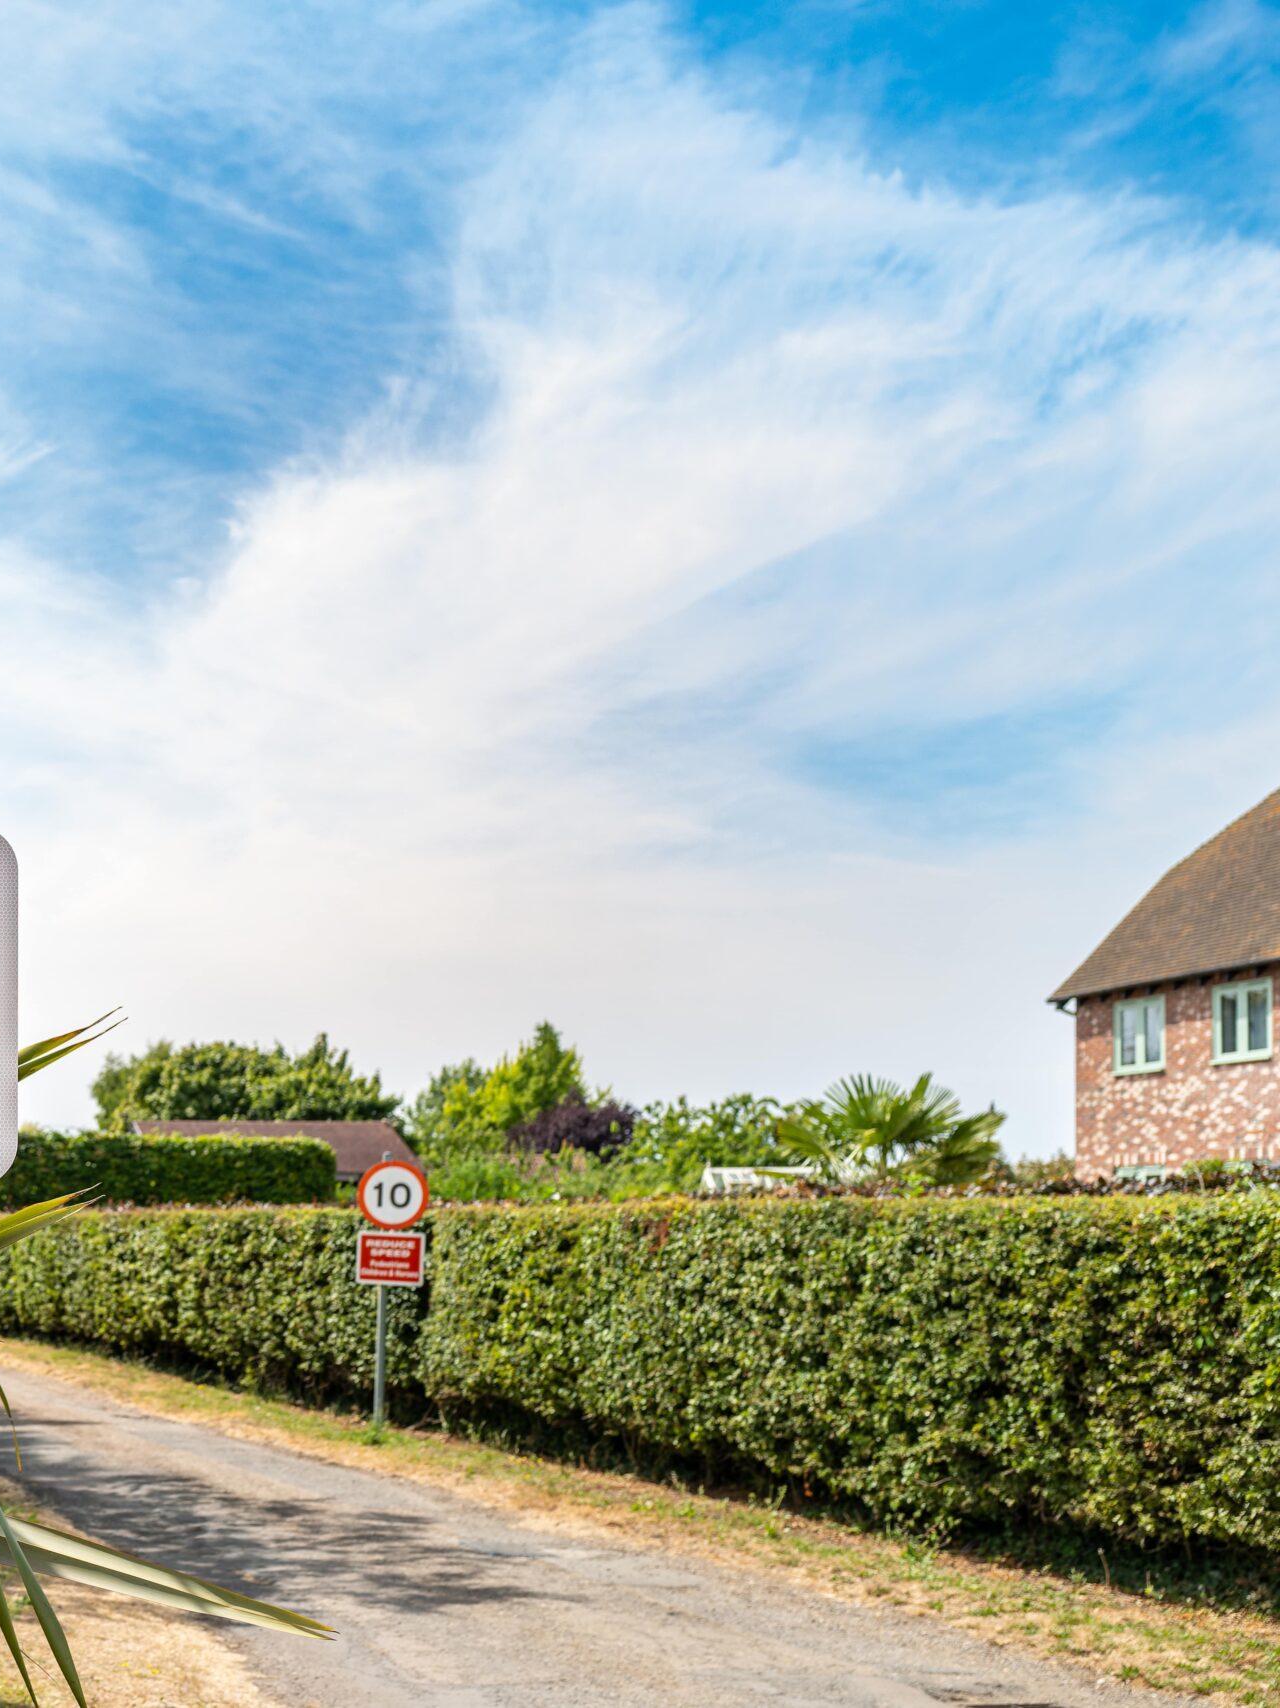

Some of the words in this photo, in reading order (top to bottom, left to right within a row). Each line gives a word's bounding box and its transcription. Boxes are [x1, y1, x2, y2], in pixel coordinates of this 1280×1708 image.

[373, 1181, 411, 1208] 10
[365, 1239, 416, 1250] REDUCE
[370, 1248, 411, 1258] SPEED
